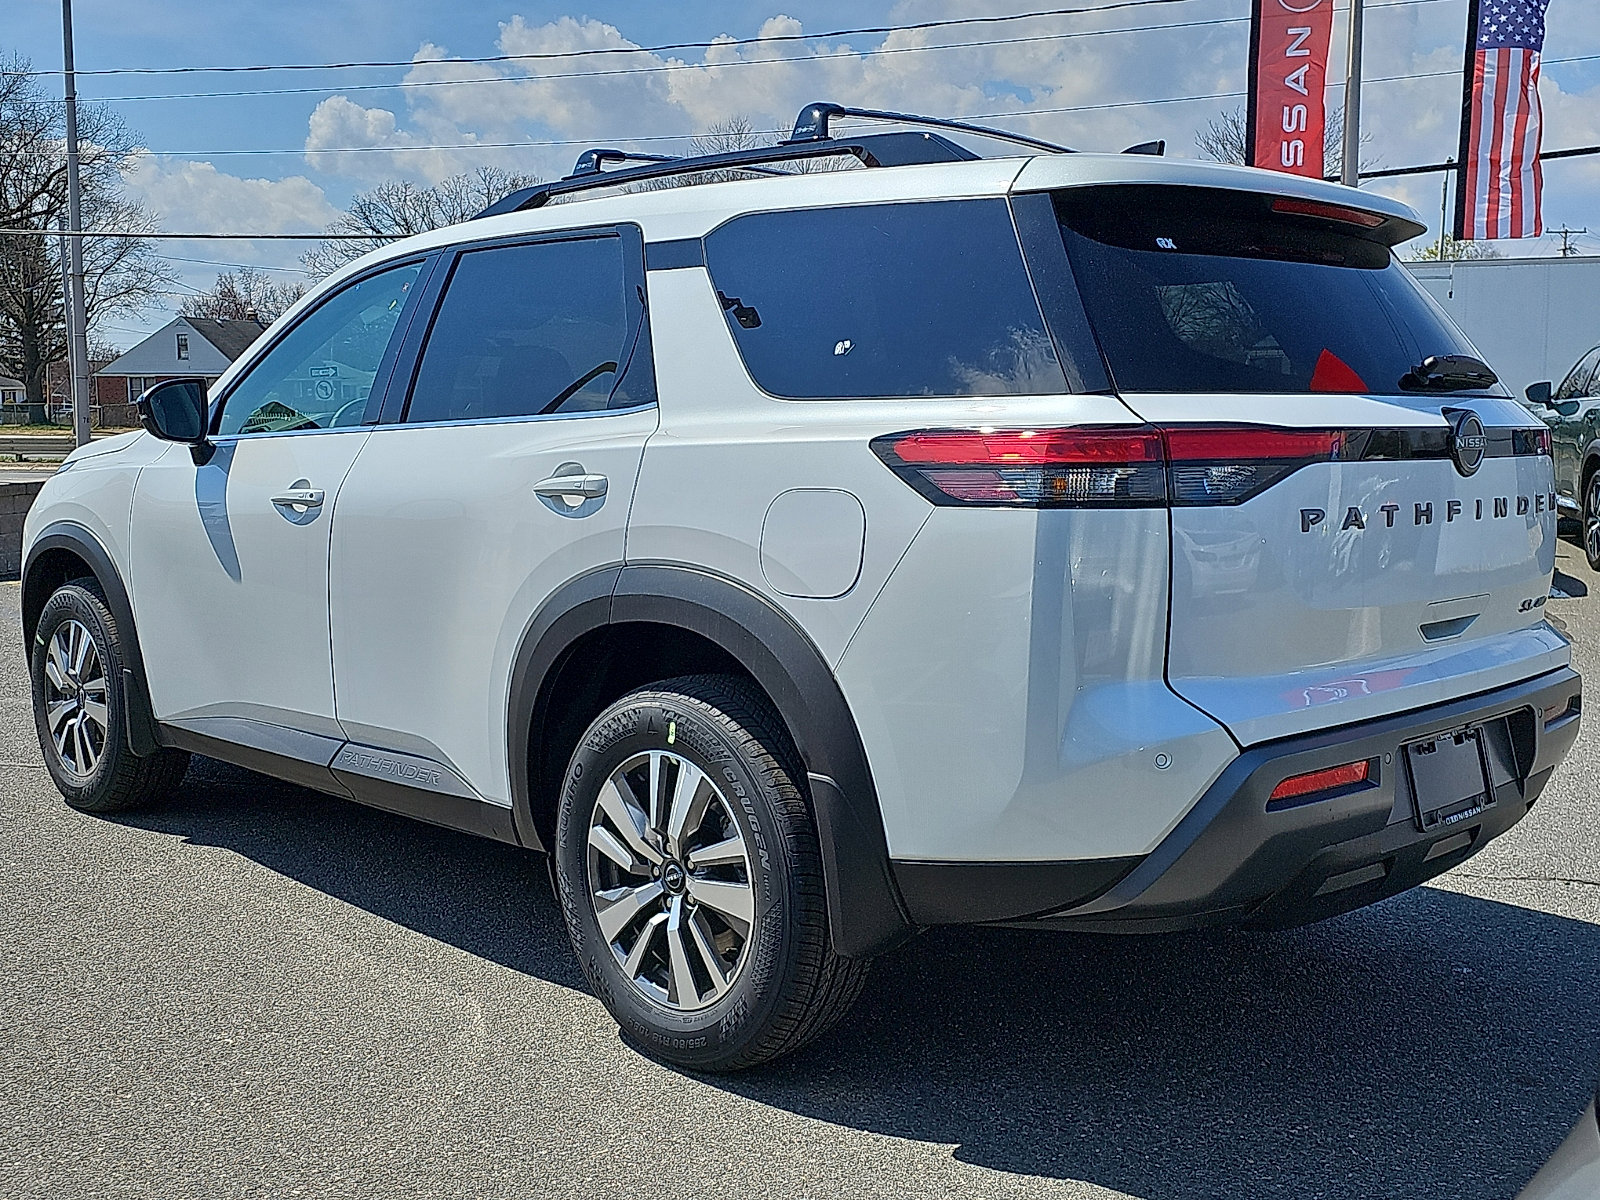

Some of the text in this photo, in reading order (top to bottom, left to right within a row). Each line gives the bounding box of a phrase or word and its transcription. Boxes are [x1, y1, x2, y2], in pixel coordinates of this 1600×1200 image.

[339, 750, 442, 786] PATHFINDER
[559, 761, 584, 850] KUMHO
[722, 765, 772, 872] CRUGEN
